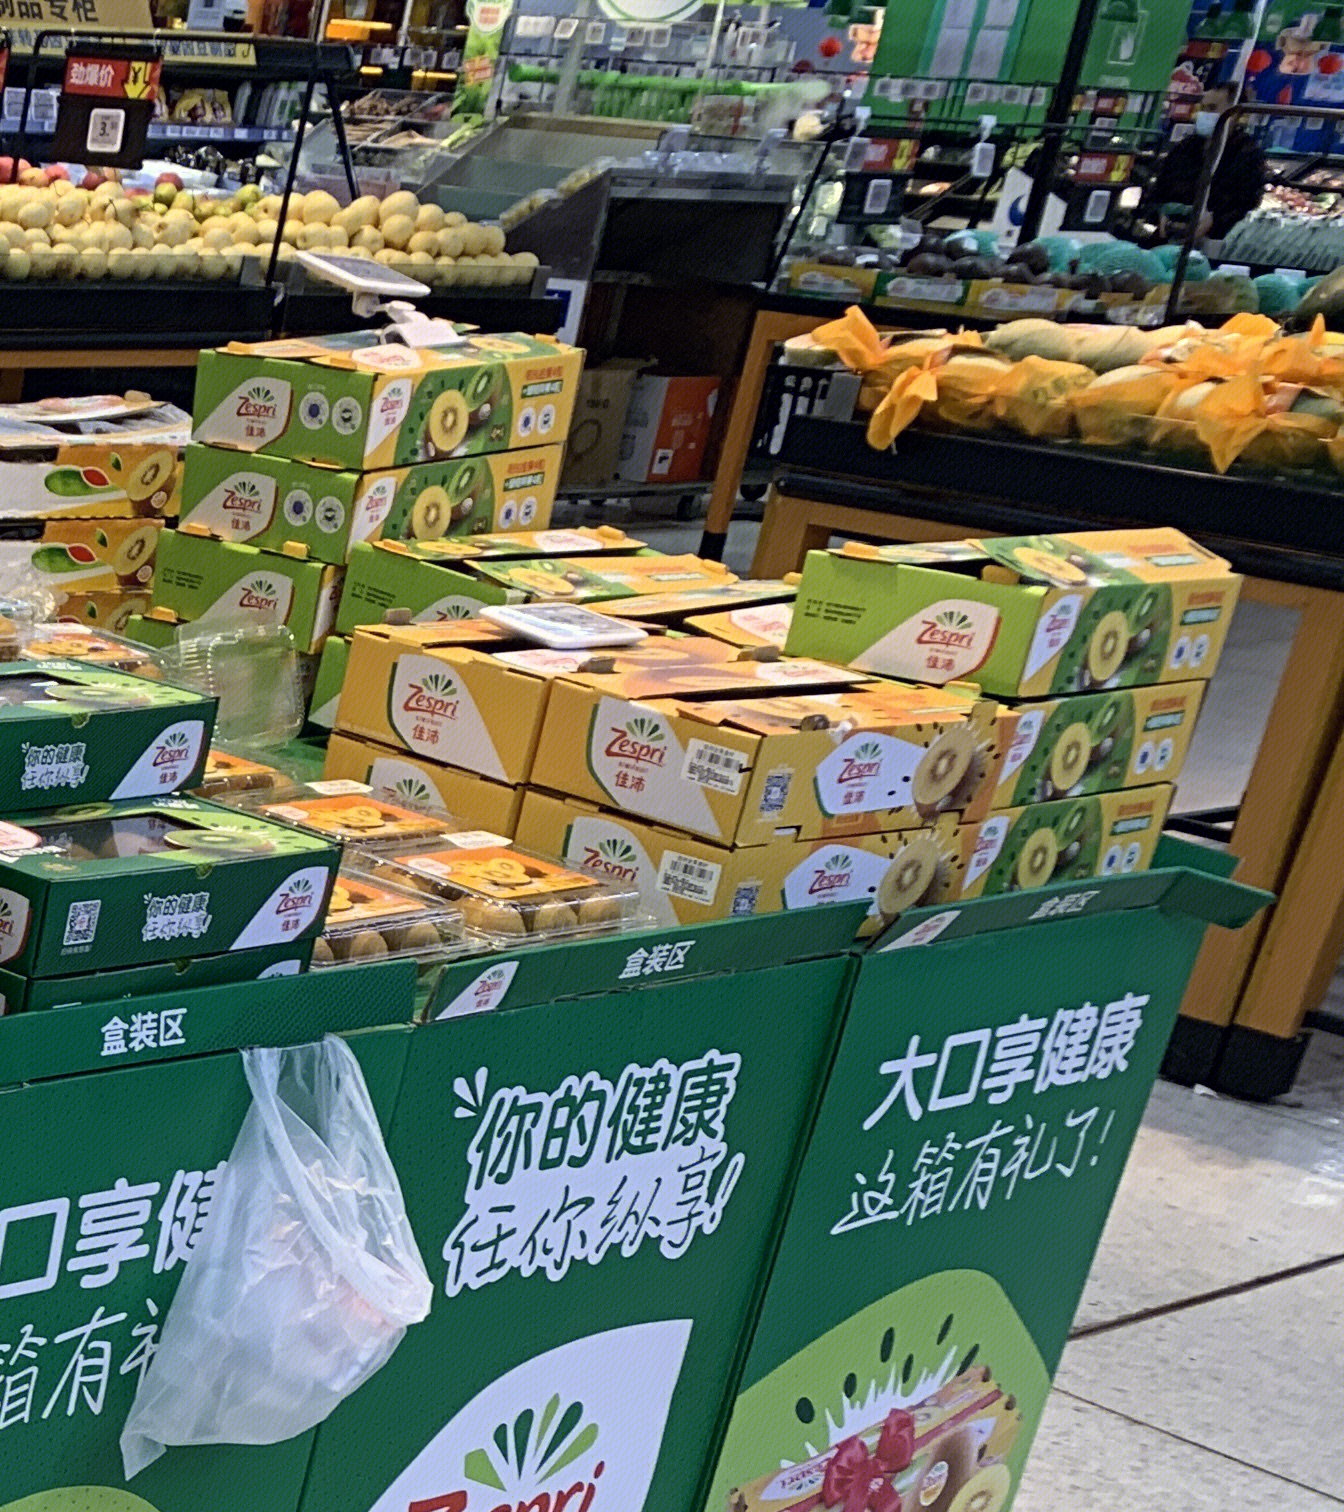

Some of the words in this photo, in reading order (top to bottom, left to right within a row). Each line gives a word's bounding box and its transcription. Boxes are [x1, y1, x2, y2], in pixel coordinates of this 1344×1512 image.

[236, 397, 277, 420] Zespri
[222, 488, 262, 512] Zespri
[239, 586, 278, 610] Zespri
[916, 621, 975, 650] Zespri
[403, 684, 460, 720] Zespri
[412, 725, 440, 745] 佳沛
[605, 728, 667, 766] Zespri
[26, 744, 86, 769] 你的健康
[153, 746, 190, 767] Zespri
[615, 770, 646, 793] 佳沛
[837, 758, 882, 784] Zespri
[808, 870, 852, 895] Zespri
[276, 894, 312, 914] Zespri
[619, 940, 696, 979] 盒装区
[100, 1008, 187, 1056] 盒装区
[863, 991, 1151, 1131] 大口享健康
[474, 1057, 734, 1190] 你的健康
[830, 1106, 1115, 1235] 这箱有礼了!
[450, 1145, 744, 1287] 任你纵享!
